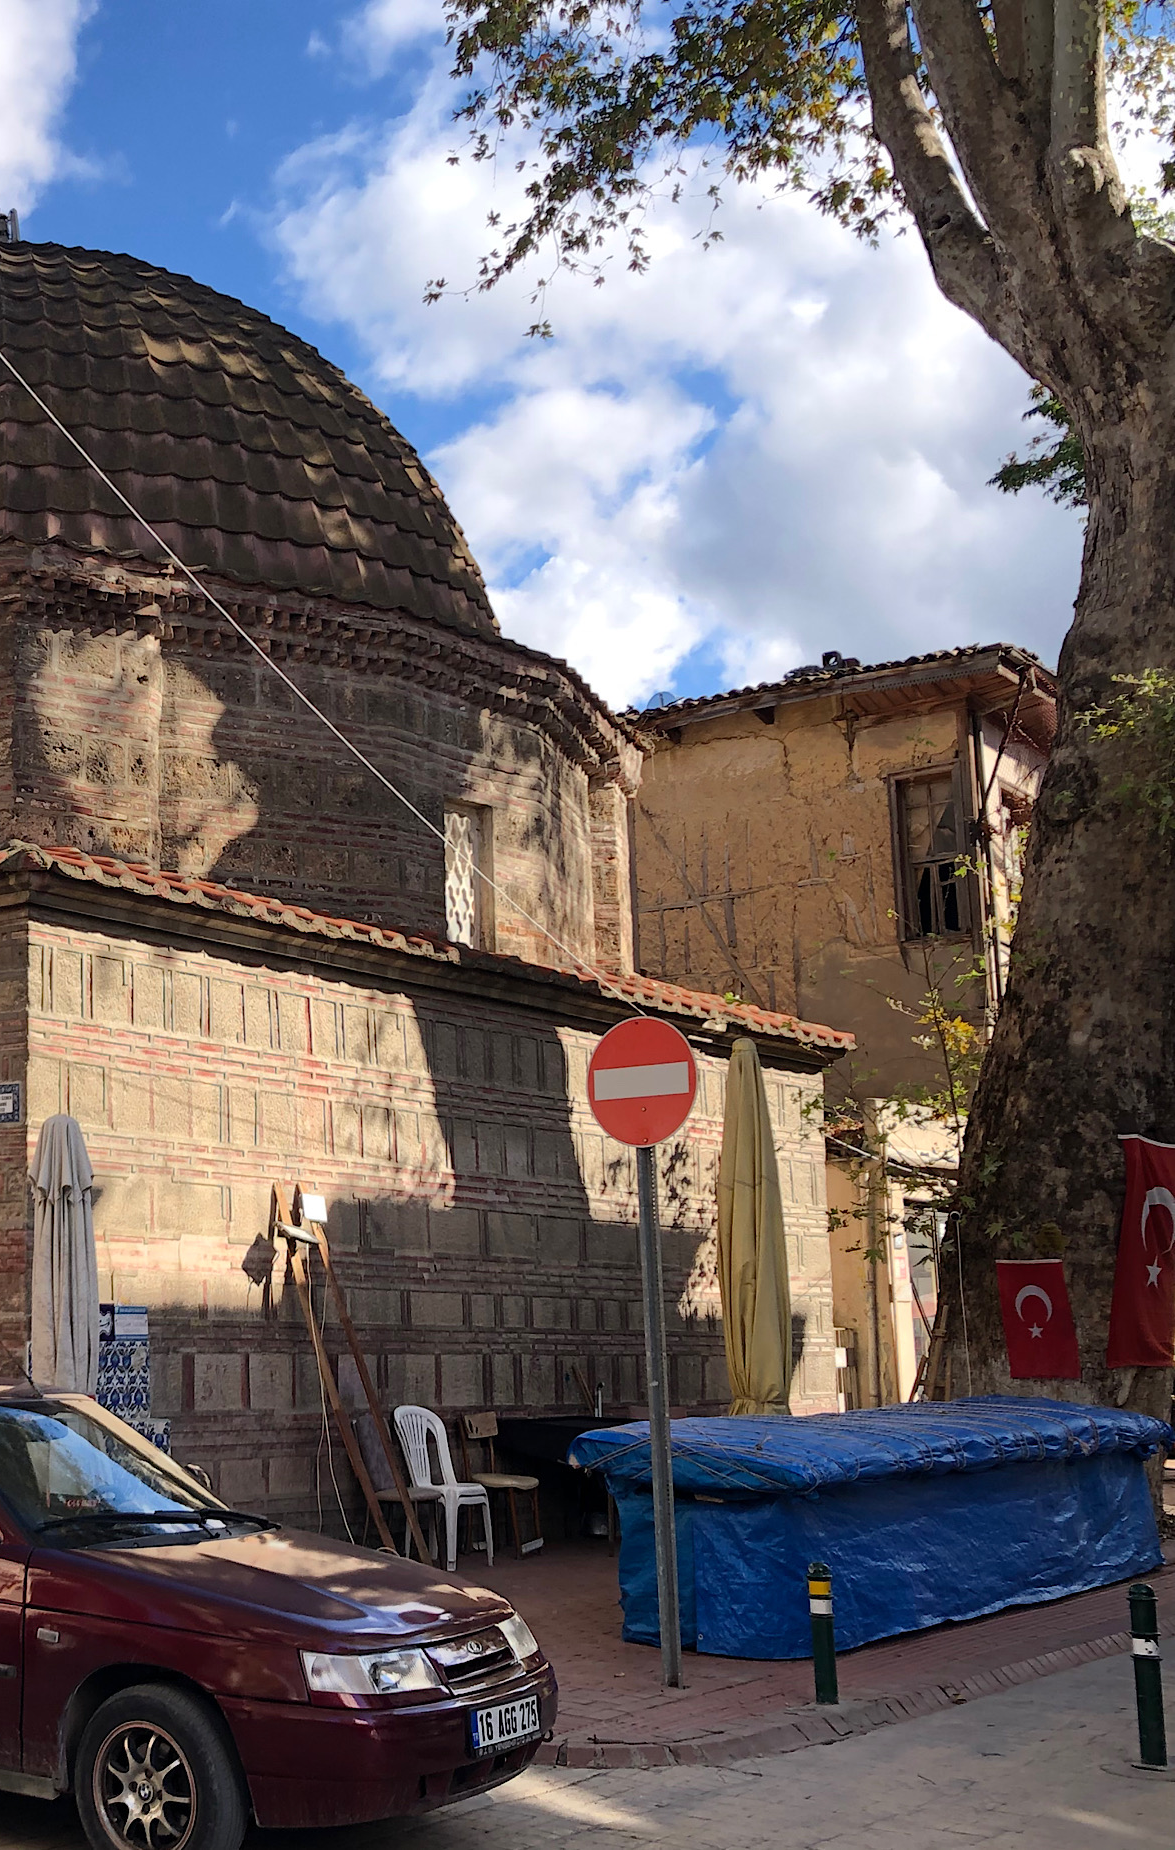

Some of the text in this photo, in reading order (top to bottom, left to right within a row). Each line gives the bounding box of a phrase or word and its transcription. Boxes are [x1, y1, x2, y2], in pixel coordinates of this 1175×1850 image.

[479, 1700, 537, 1742] 16 AGG 275
